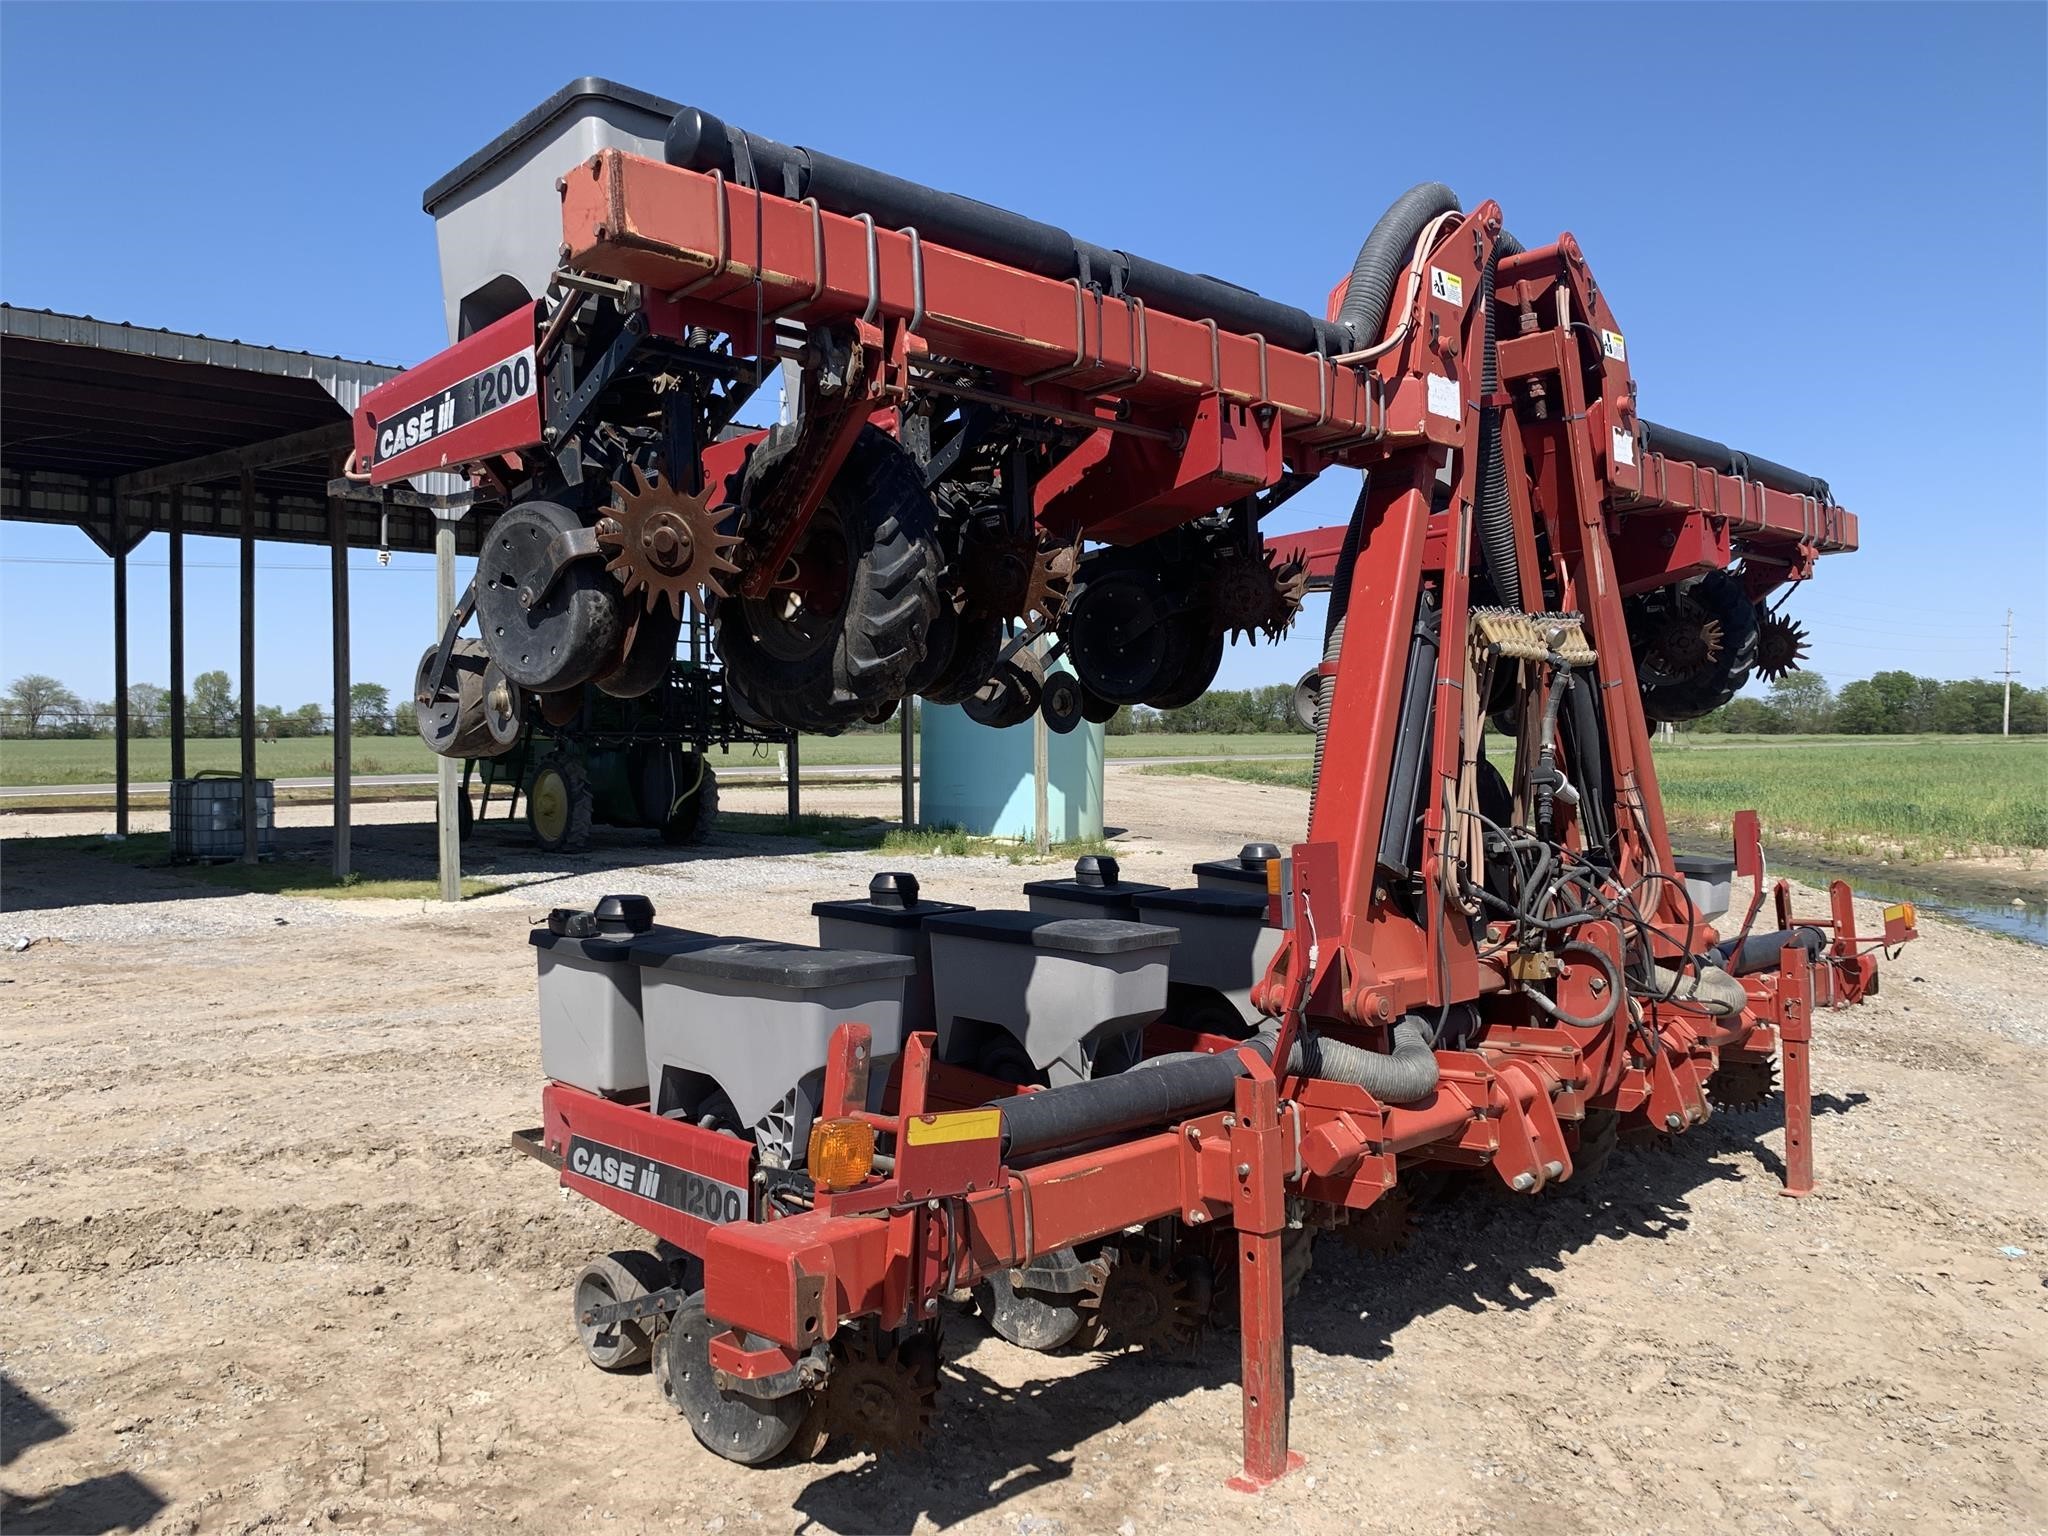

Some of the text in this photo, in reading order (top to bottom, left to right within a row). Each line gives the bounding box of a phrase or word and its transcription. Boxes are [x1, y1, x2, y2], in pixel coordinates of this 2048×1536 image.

[380, 409, 435, 459] CASE
[473, 356, 530, 417] 1200
[573, 1147, 636, 1191] CASE
[676, 1174, 741, 1223] 1200
